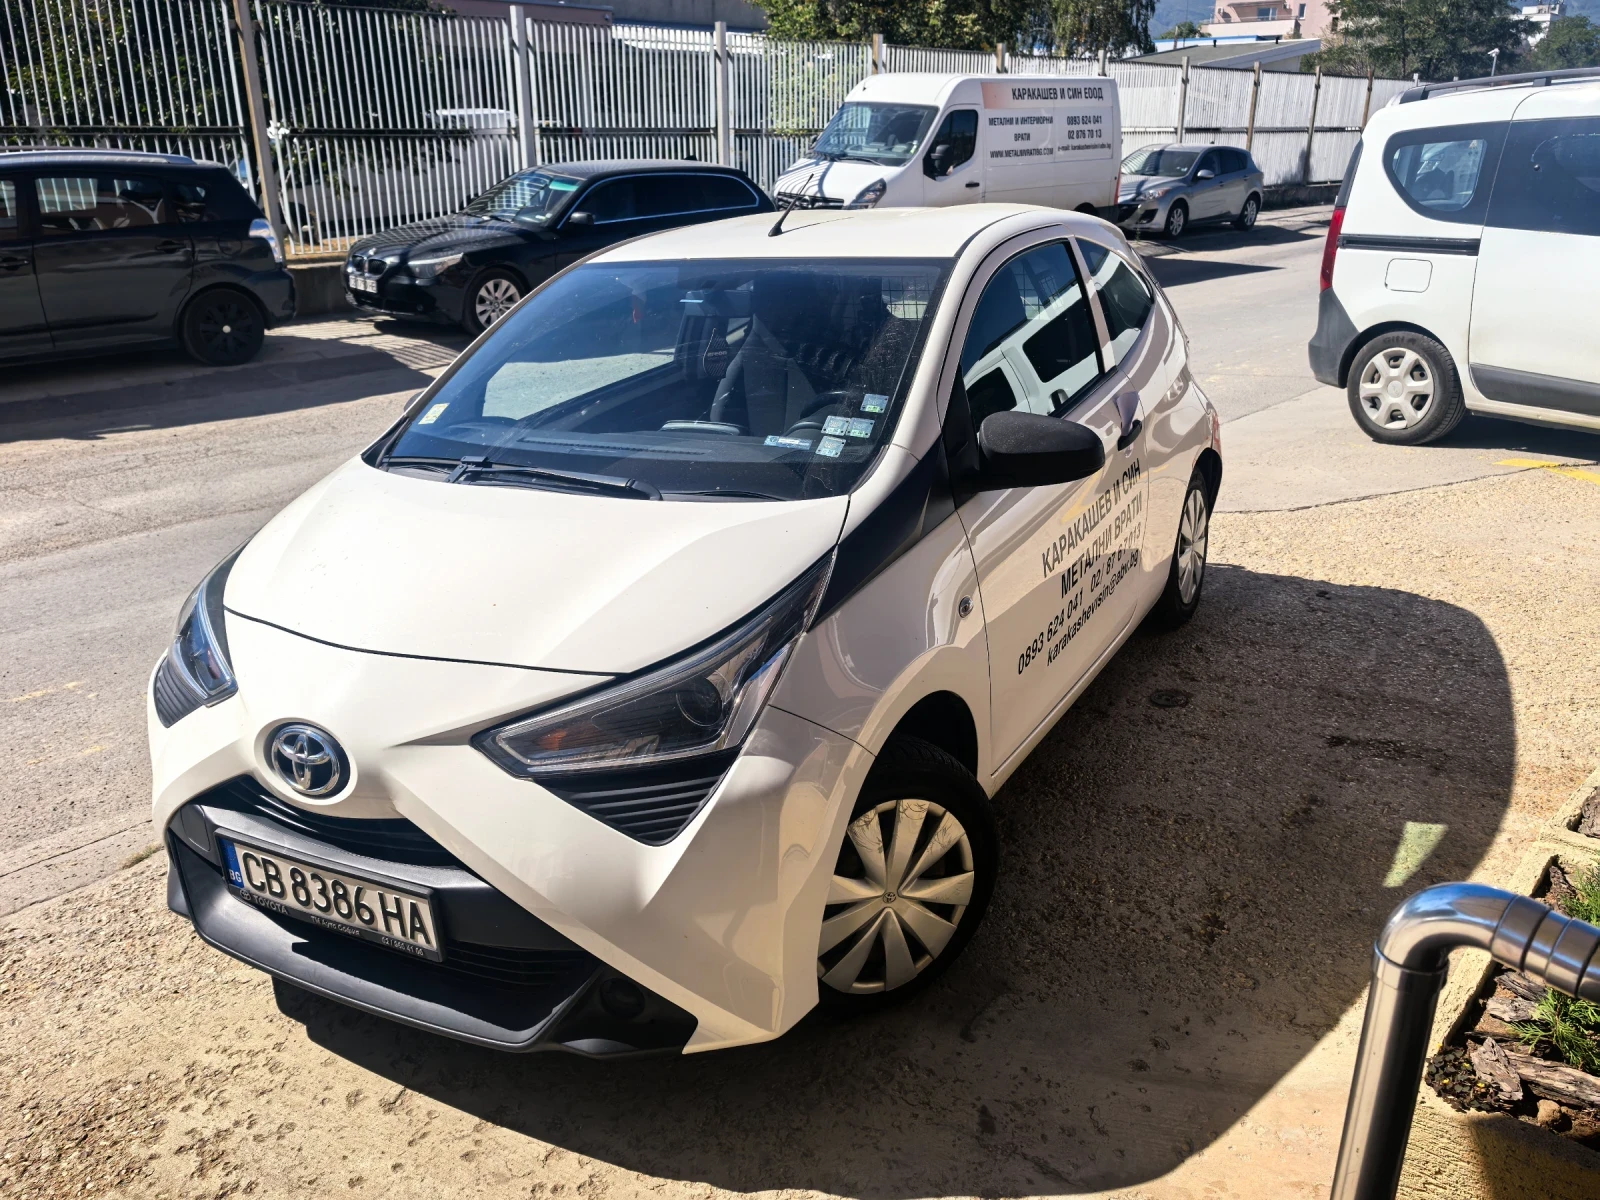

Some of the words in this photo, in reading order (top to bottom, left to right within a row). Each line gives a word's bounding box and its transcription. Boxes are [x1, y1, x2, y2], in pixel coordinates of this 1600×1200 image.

[1012, 87, 1057, 101] КАРАКАШЕВ
[1060, 88, 1066, 100] И
[1067, 88, 1082, 99] СИН
[1084, 87, 1104, 101] ЕООД
[988, 117, 1014, 126] МЕТАЛНИ
[1015, 117, 1019, 125] И
[1020, 116, 1053, 125] ИНТЕРИОРНИ
[1066, 115, 1080, 125] 0893
[1081, 115, 1092, 125] 624
[1093, 115, 1102, 124] 041
[1014, 133, 1030, 141] ВРАТИ
[1067, 130, 1075, 139] 02
[1076, 129, 1086, 139] 876
[1087, 129, 1094, 138] 70
[1095, 129, 1102, 138] 13
[1042, 495, 1112, 578] КАРАКАШЕВ
[1113, 484, 1121, 506] И
[1122, 458, 1141, 495] СИН
[1061, 528, 1112, 599] МЕТАЛНИ
[1114, 490, 1142, 540] ВРАТИ
[1047, 549, 1139, 667] karakashevisin@abv.bg
[1018, 632, 1044, 675] 0893
[1047, 610, 1065, 642] 624
[1067, 589, 1084, 619] 041
[229, 869, 242, 883] BG
[253, 895, 289, 915] TOYOTA
[290, 867, 375, 926] 8386
